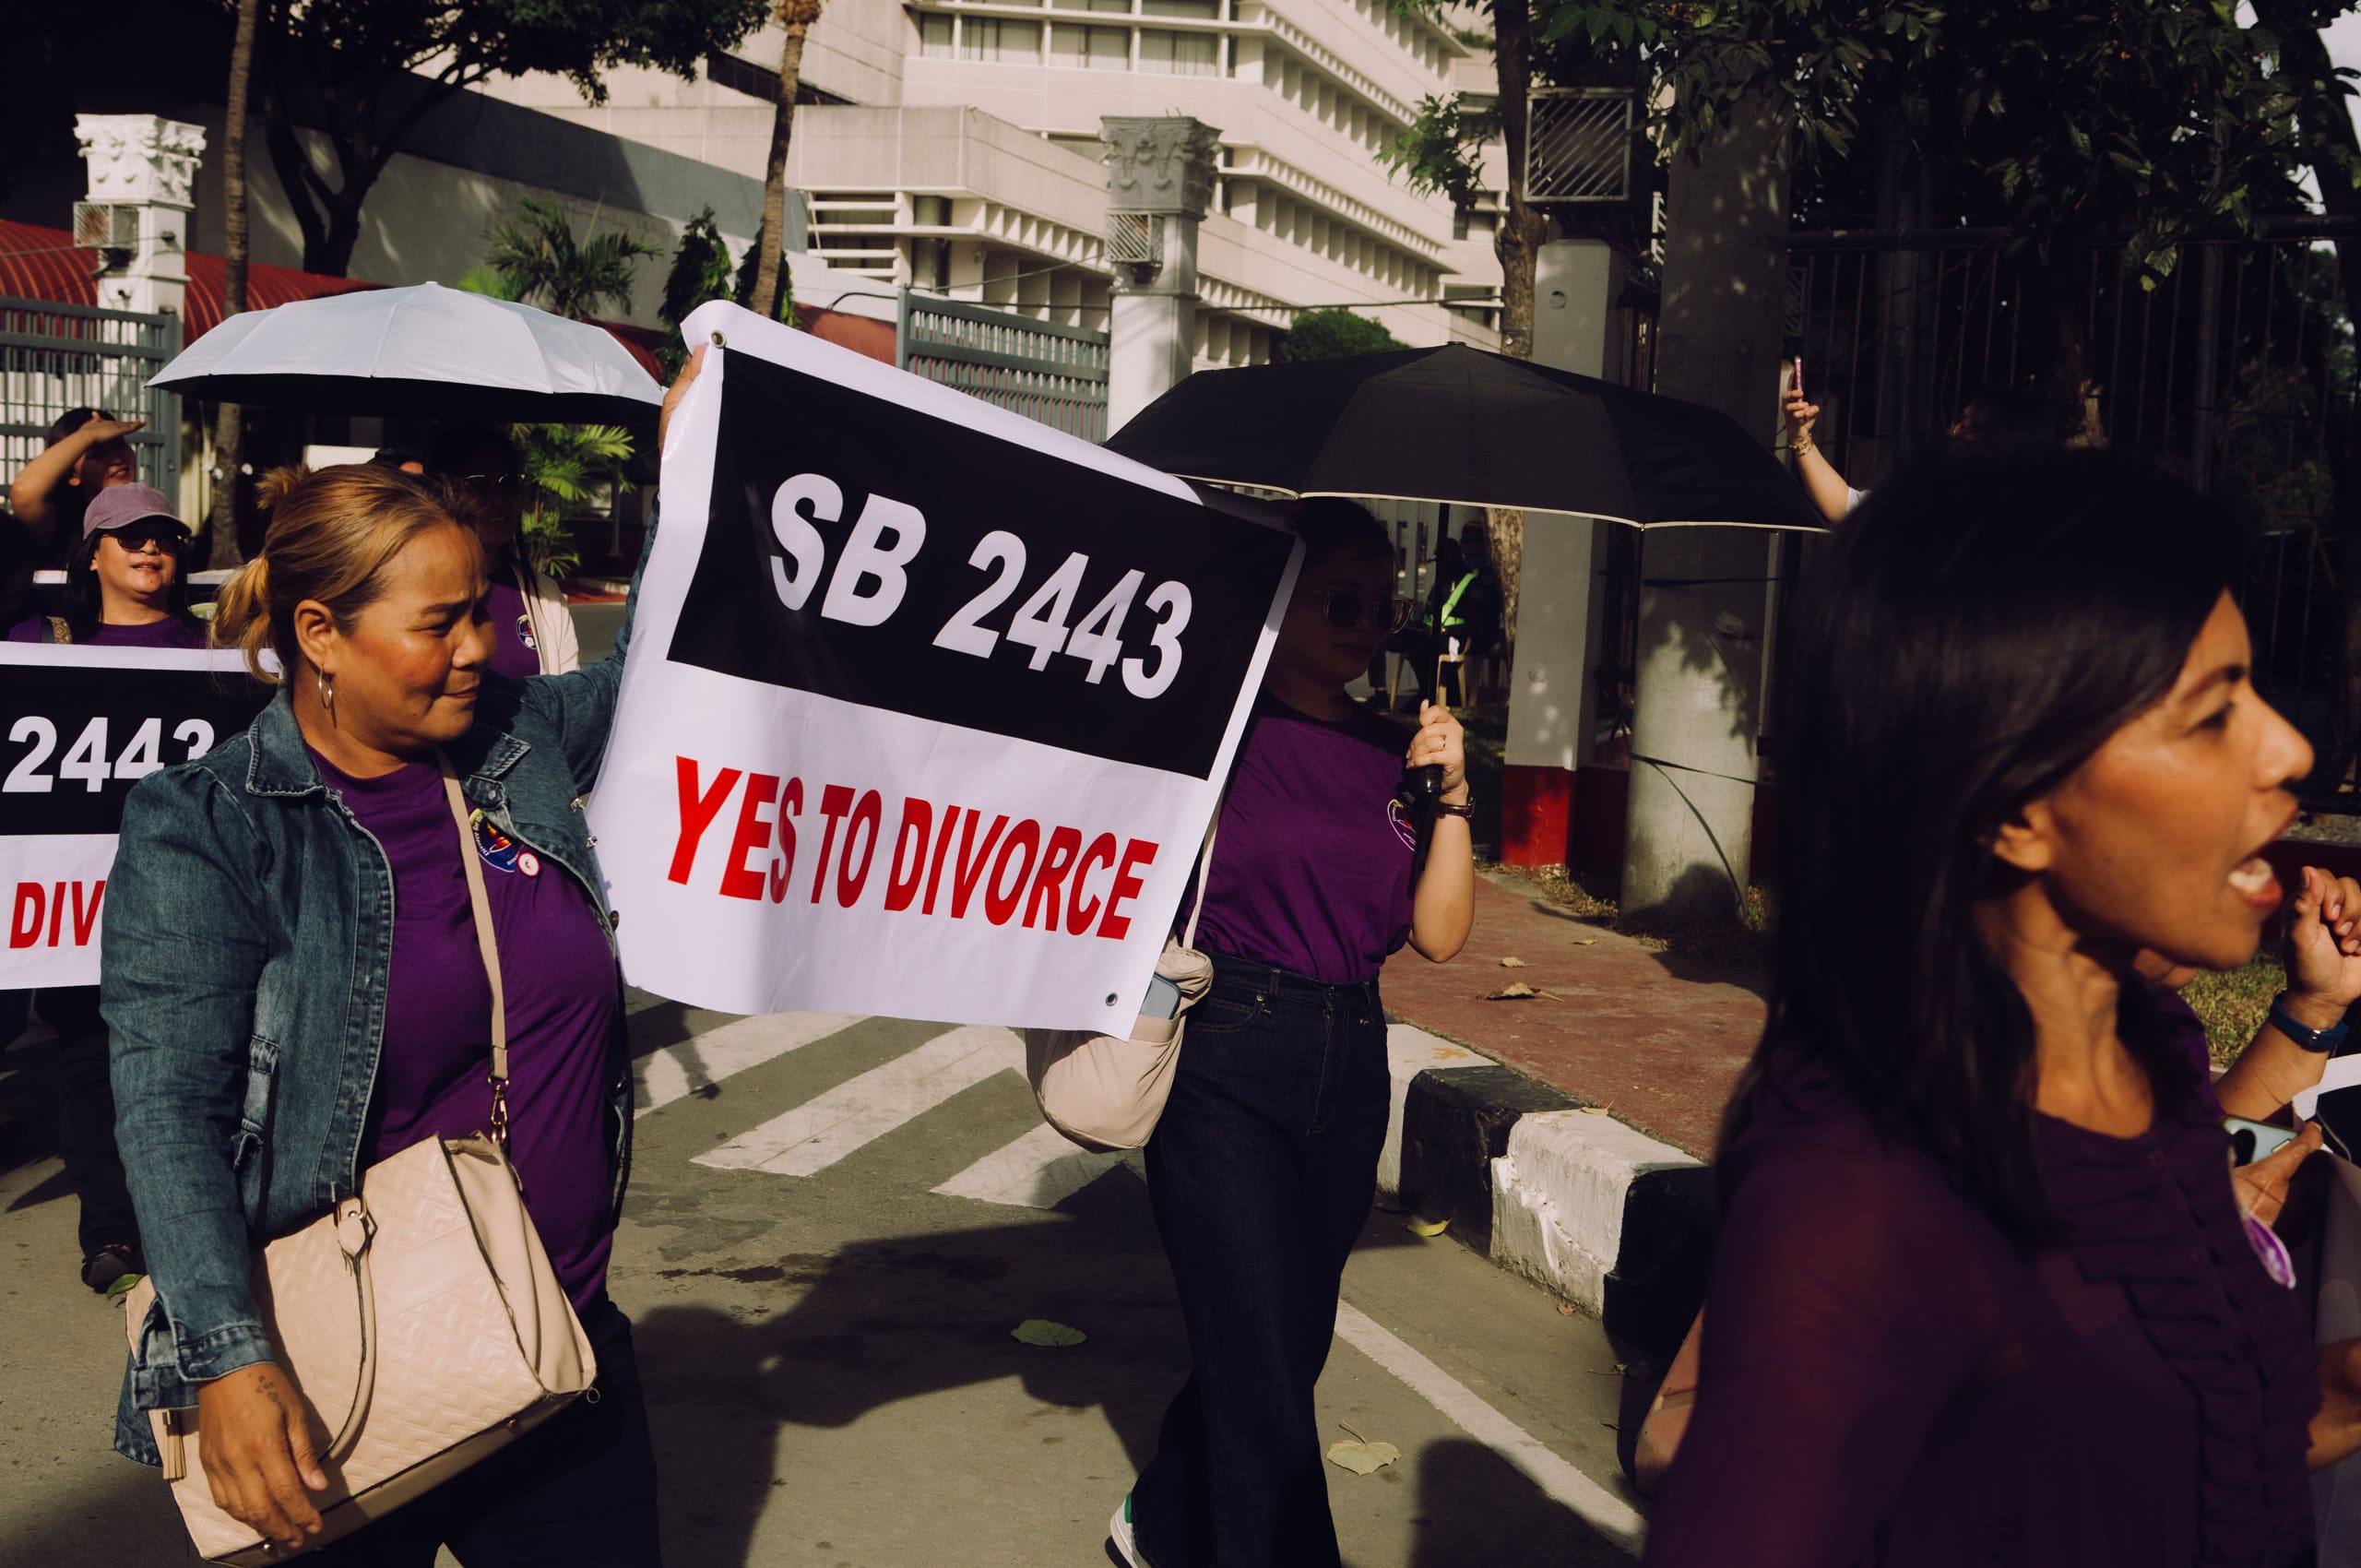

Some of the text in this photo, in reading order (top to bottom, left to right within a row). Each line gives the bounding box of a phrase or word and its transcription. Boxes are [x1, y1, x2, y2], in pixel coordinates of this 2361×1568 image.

[771, 473, 1192, 698] SB 2443
[668, 755, 1158, 940] YES TO DIVORCE
